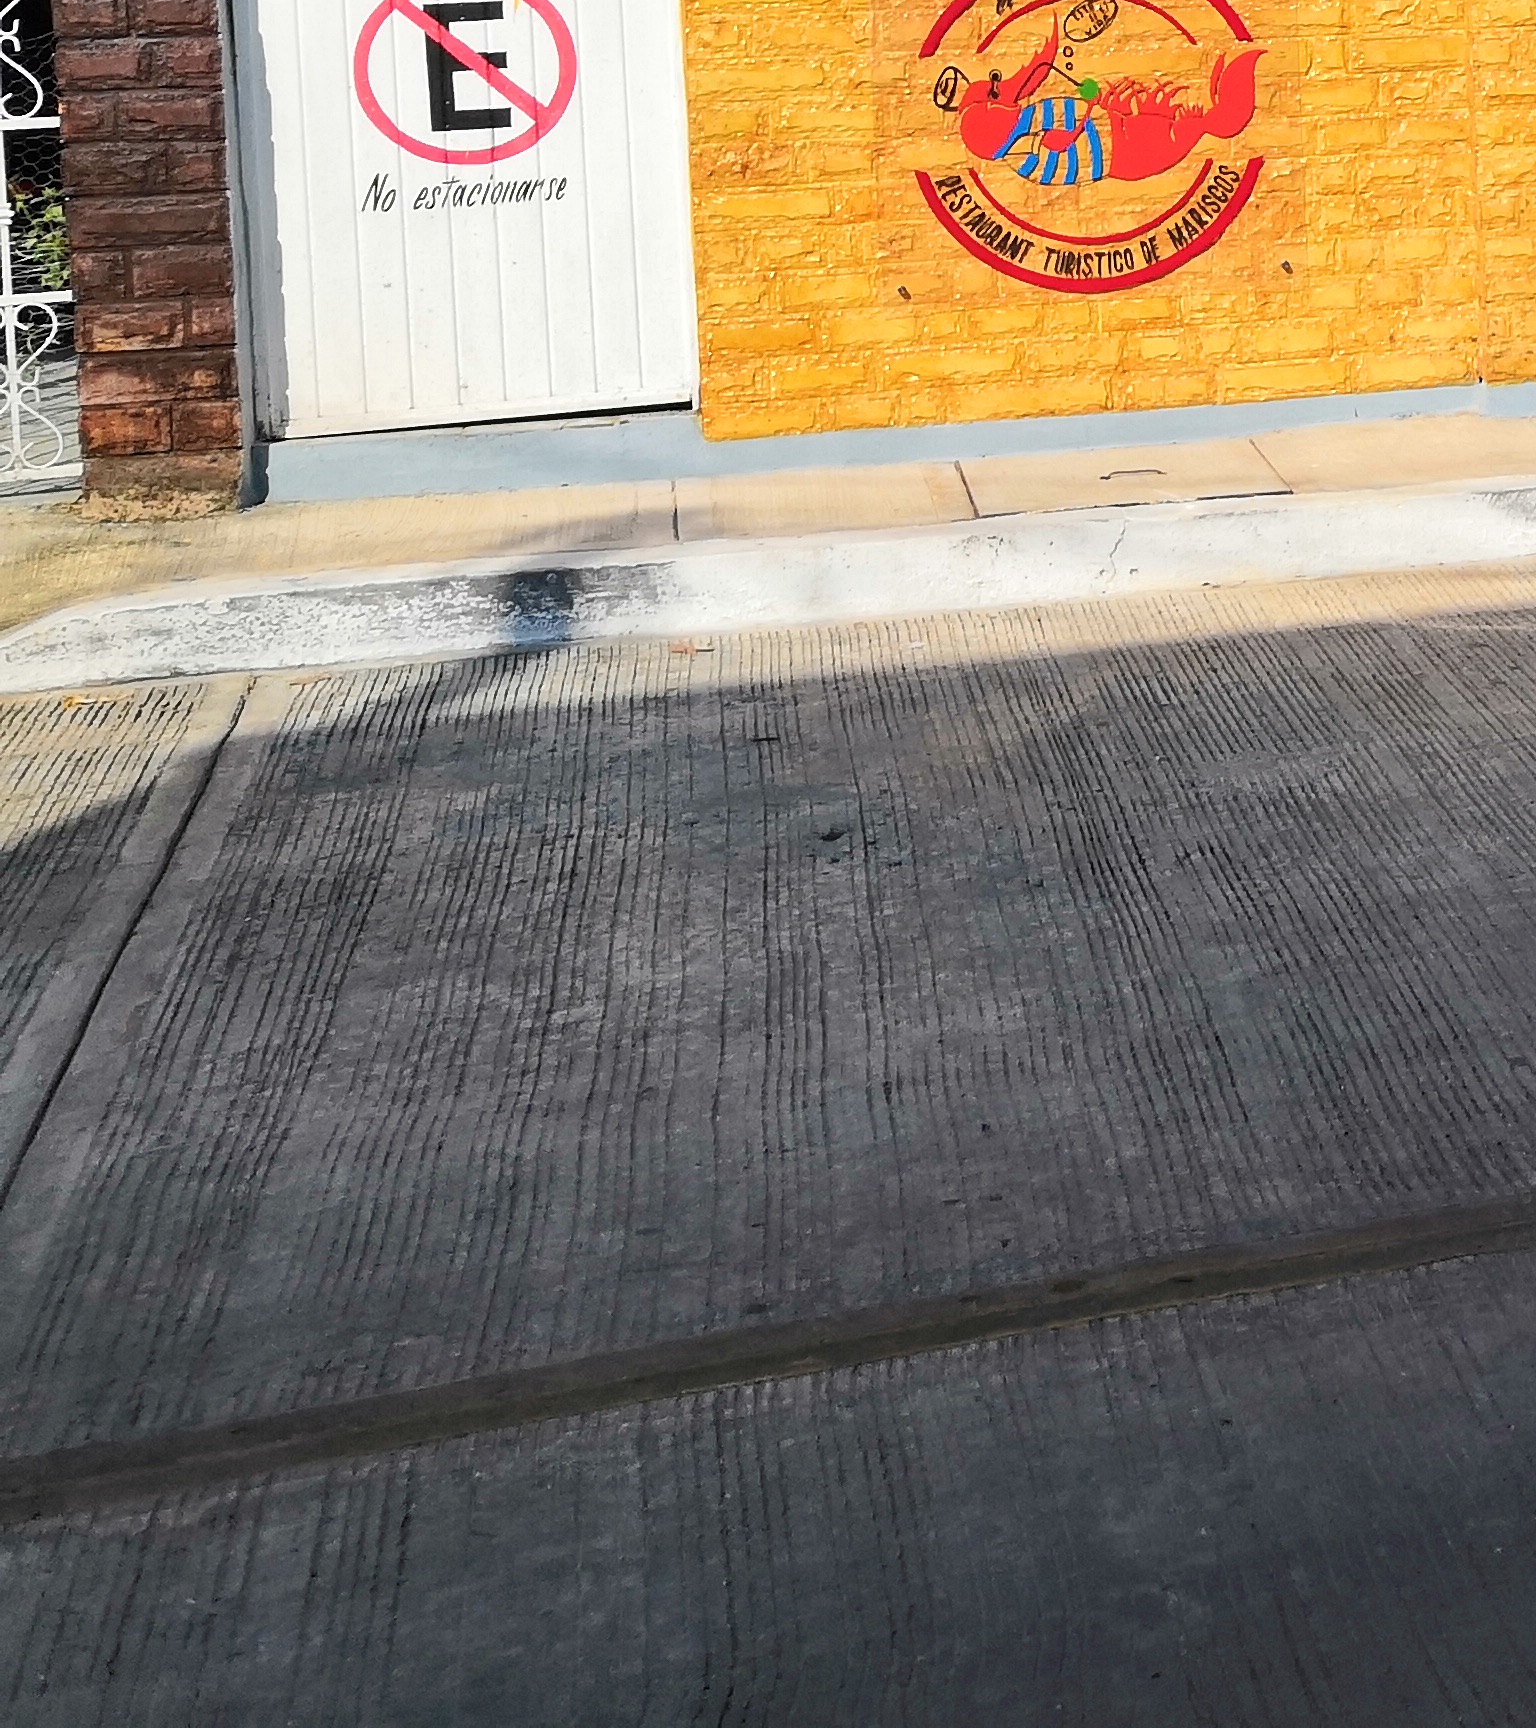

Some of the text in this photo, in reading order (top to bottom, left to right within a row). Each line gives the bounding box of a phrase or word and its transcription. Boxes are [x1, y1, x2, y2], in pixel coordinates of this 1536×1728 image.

[361, 172, 568, 213] No estacionarse
[934, 164, 1241, 279] RESTAURANT TURISTICO DE MARISCOS
